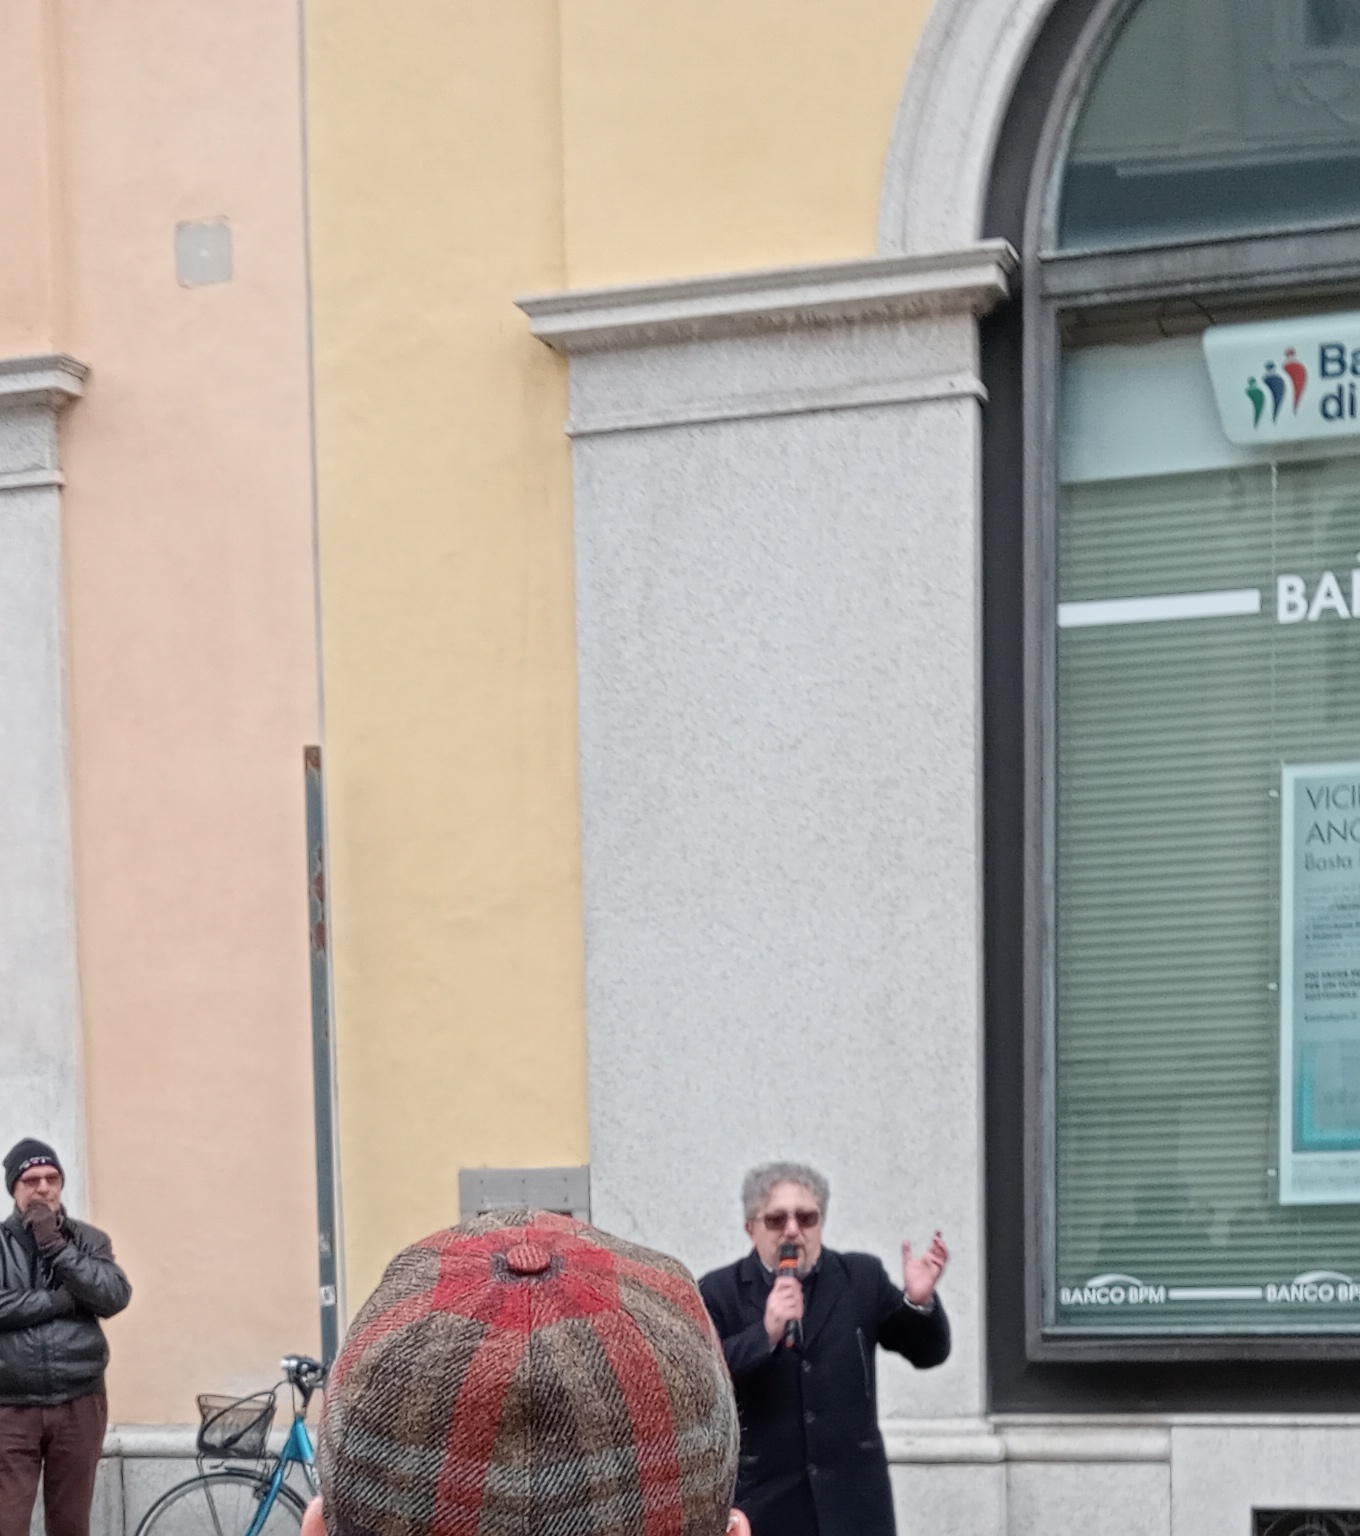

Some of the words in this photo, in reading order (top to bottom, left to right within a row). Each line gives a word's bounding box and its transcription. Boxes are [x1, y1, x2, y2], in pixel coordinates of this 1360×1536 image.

[1320, 381, 1356, 421] di
[1060, 1285, 1126, 1305] BANCO
[1128, 1285, 1165, 1304] BPM
[1266, 1283, 1335, 1303] BANCO
